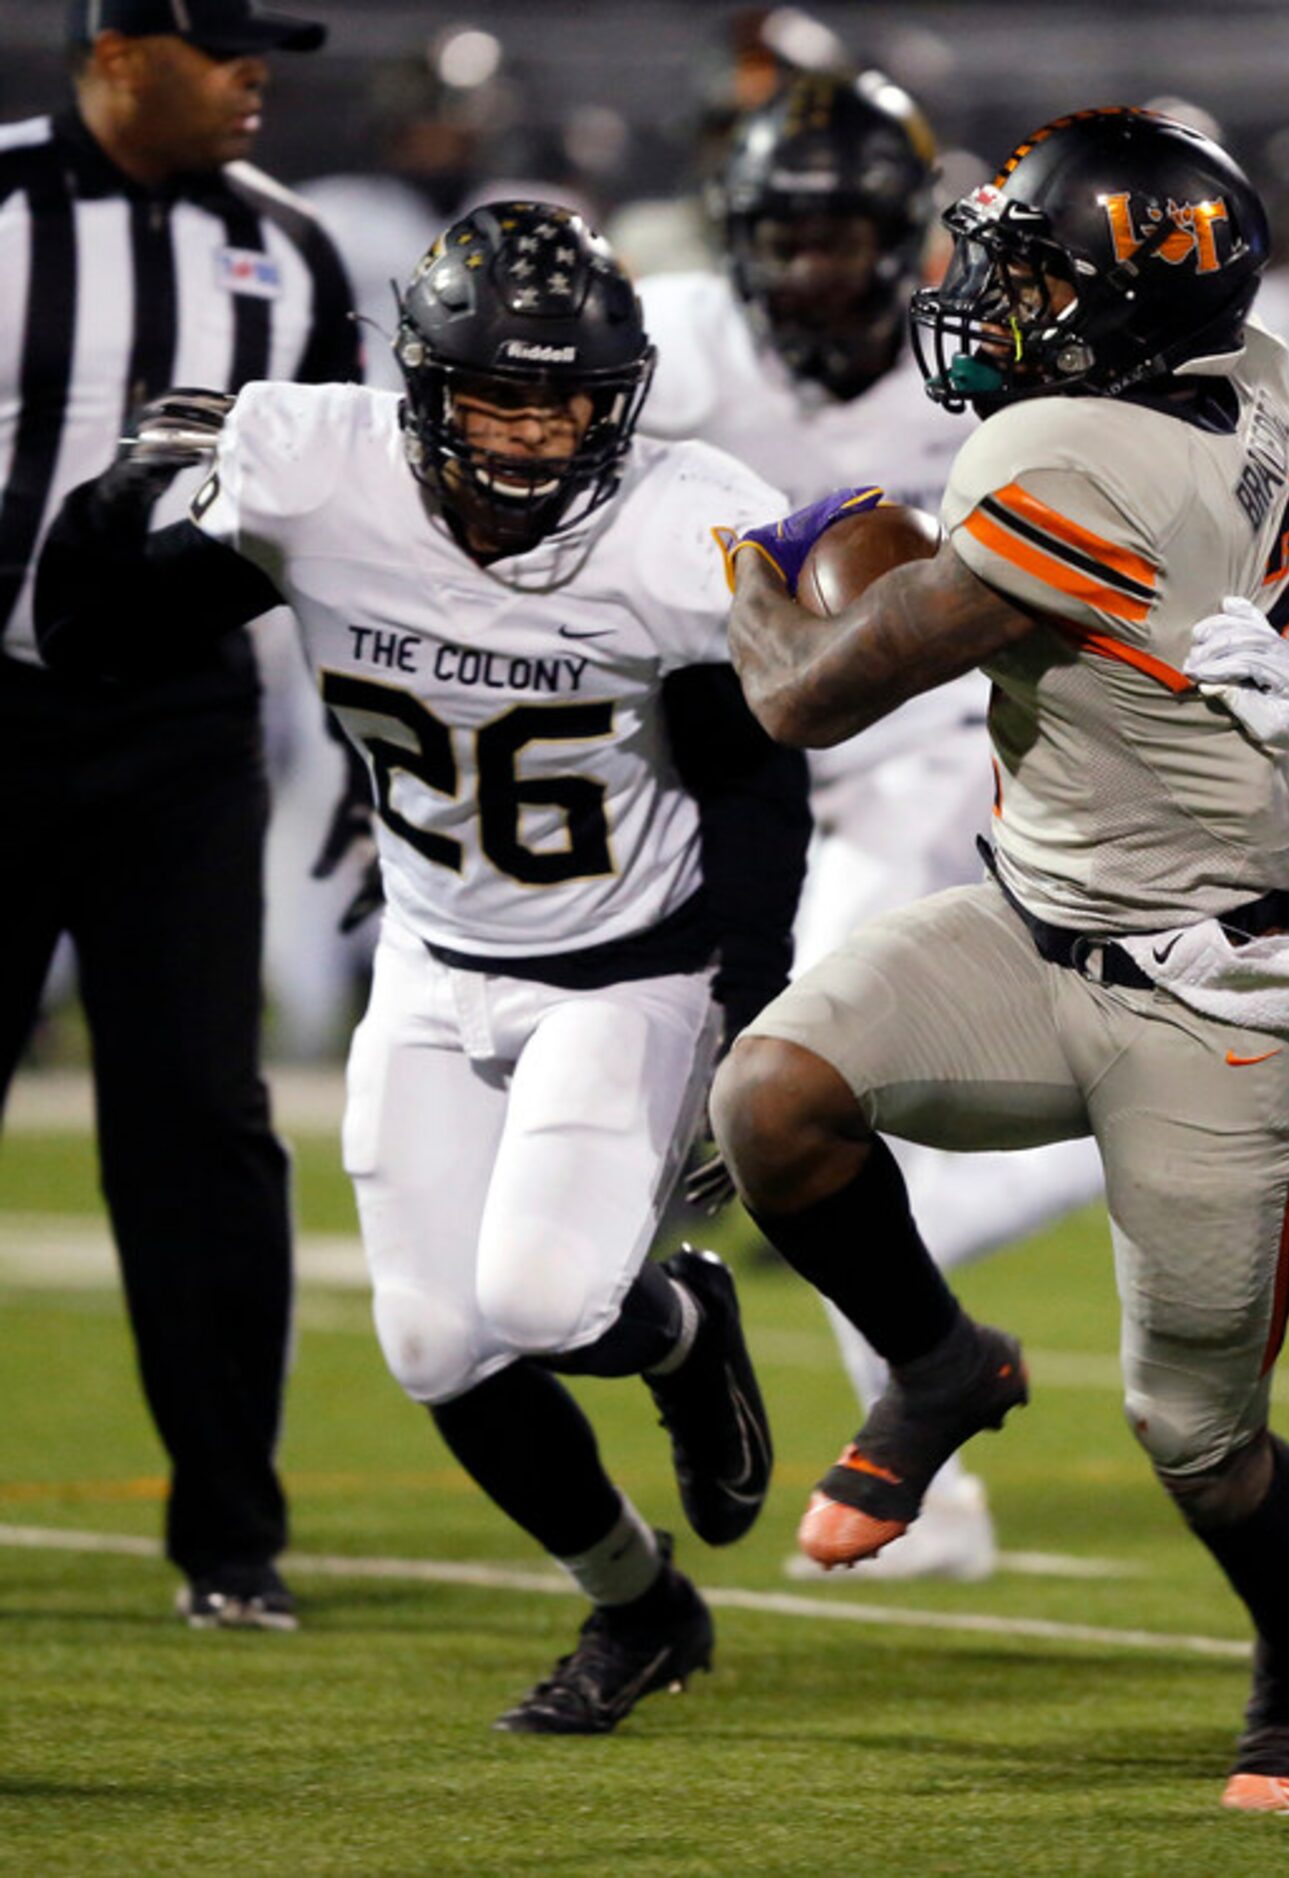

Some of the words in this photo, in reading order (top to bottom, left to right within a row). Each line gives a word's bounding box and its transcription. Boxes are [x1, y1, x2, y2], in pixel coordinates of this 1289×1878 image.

[349, 626, 421, 673] THE
[433, 644, 588, 692] COLONY
[318, 668, 620, 888] 26
